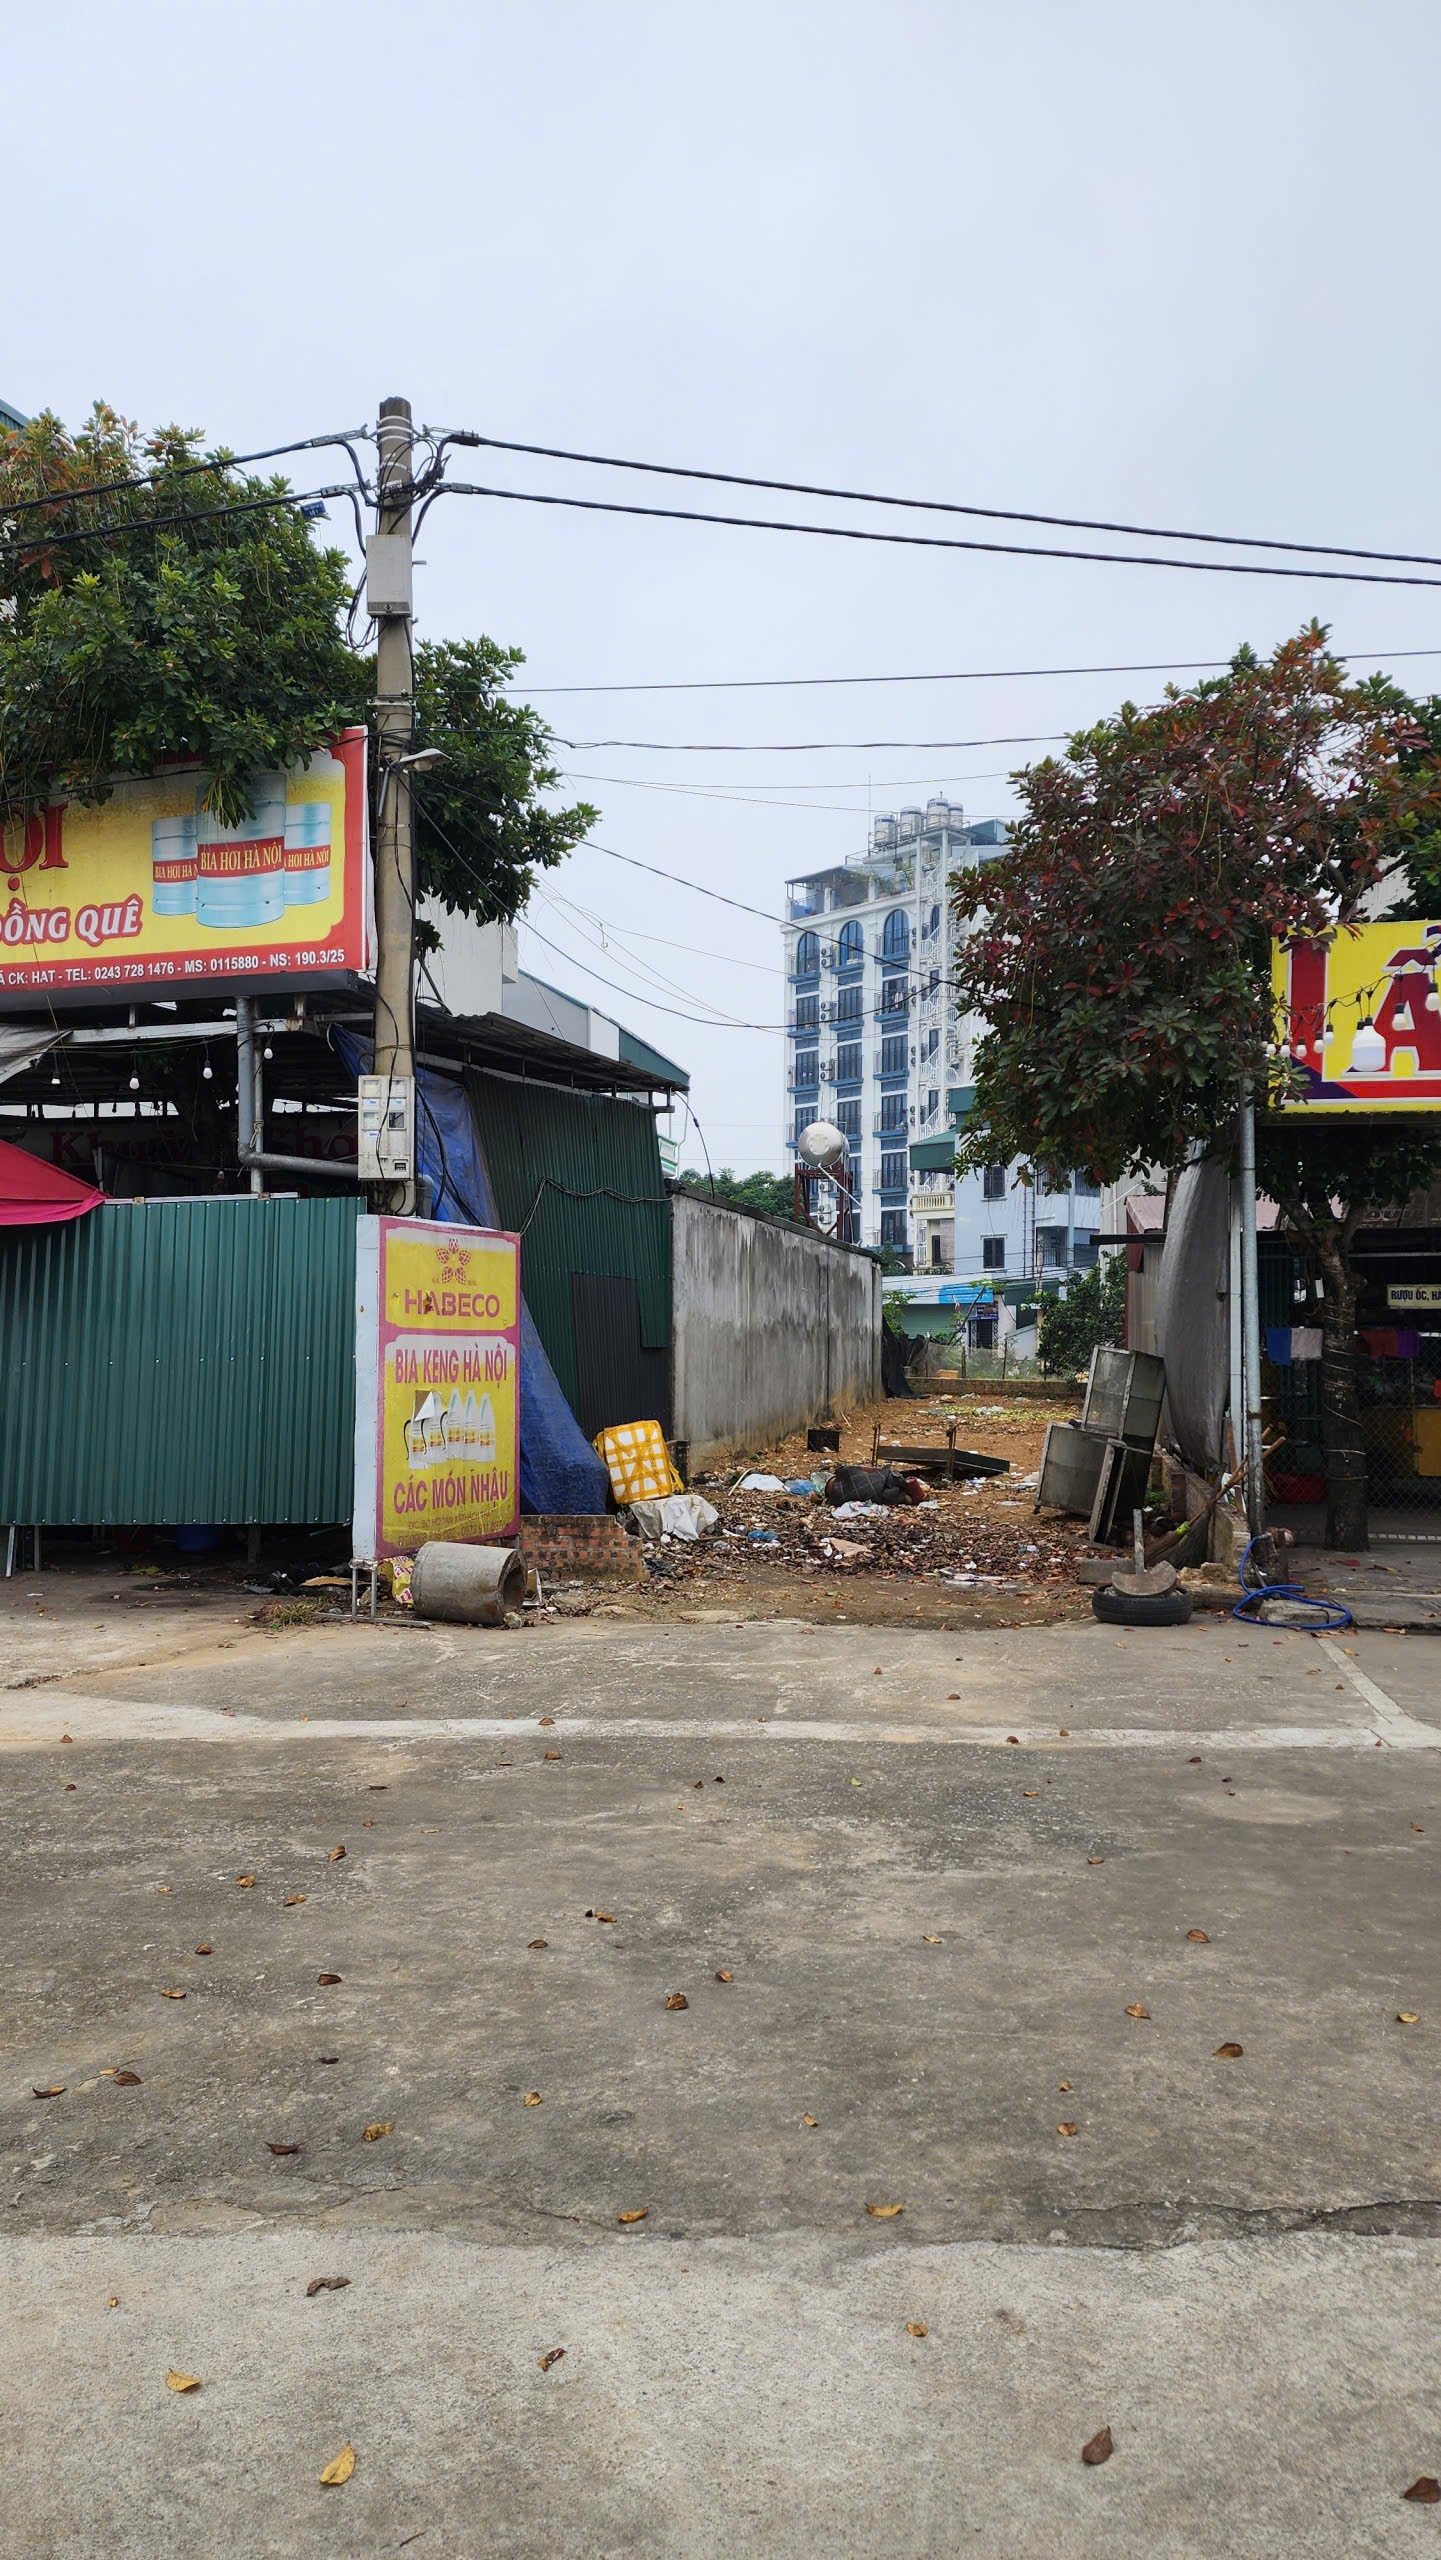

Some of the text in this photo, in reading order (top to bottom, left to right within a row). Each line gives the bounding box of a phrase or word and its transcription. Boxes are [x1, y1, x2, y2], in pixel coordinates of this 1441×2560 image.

[200, 852, 218, 871] BIA
[243, 844, 260, 869] HÀ
[263, 841, 282, 870] NỘI
[0, 898, 140, 943] ỒNG QUÊ
[8, 971, 29, 985] CK:
[32, 970, 56, 984] HAT
[67, 968, 91, 982] TEL:
[95, 965, 121, 980] 0243
[124, 963, 144, 978] 728
[148, 961, 174, 976] 1476
[185, 959, 207, 973] MS:
[210, 956, 259, 971] 0115880
[270, 953, 291, 967] NS:
[295, 949, 345, 965] 190.3/25
[405, 1289, 500, 1318] HABECO
[395, 1342, 507, 1389] BIA KENG HÀ NỘI
[394, 1466, 508, 1515] CÁC MÓN NHẬU
